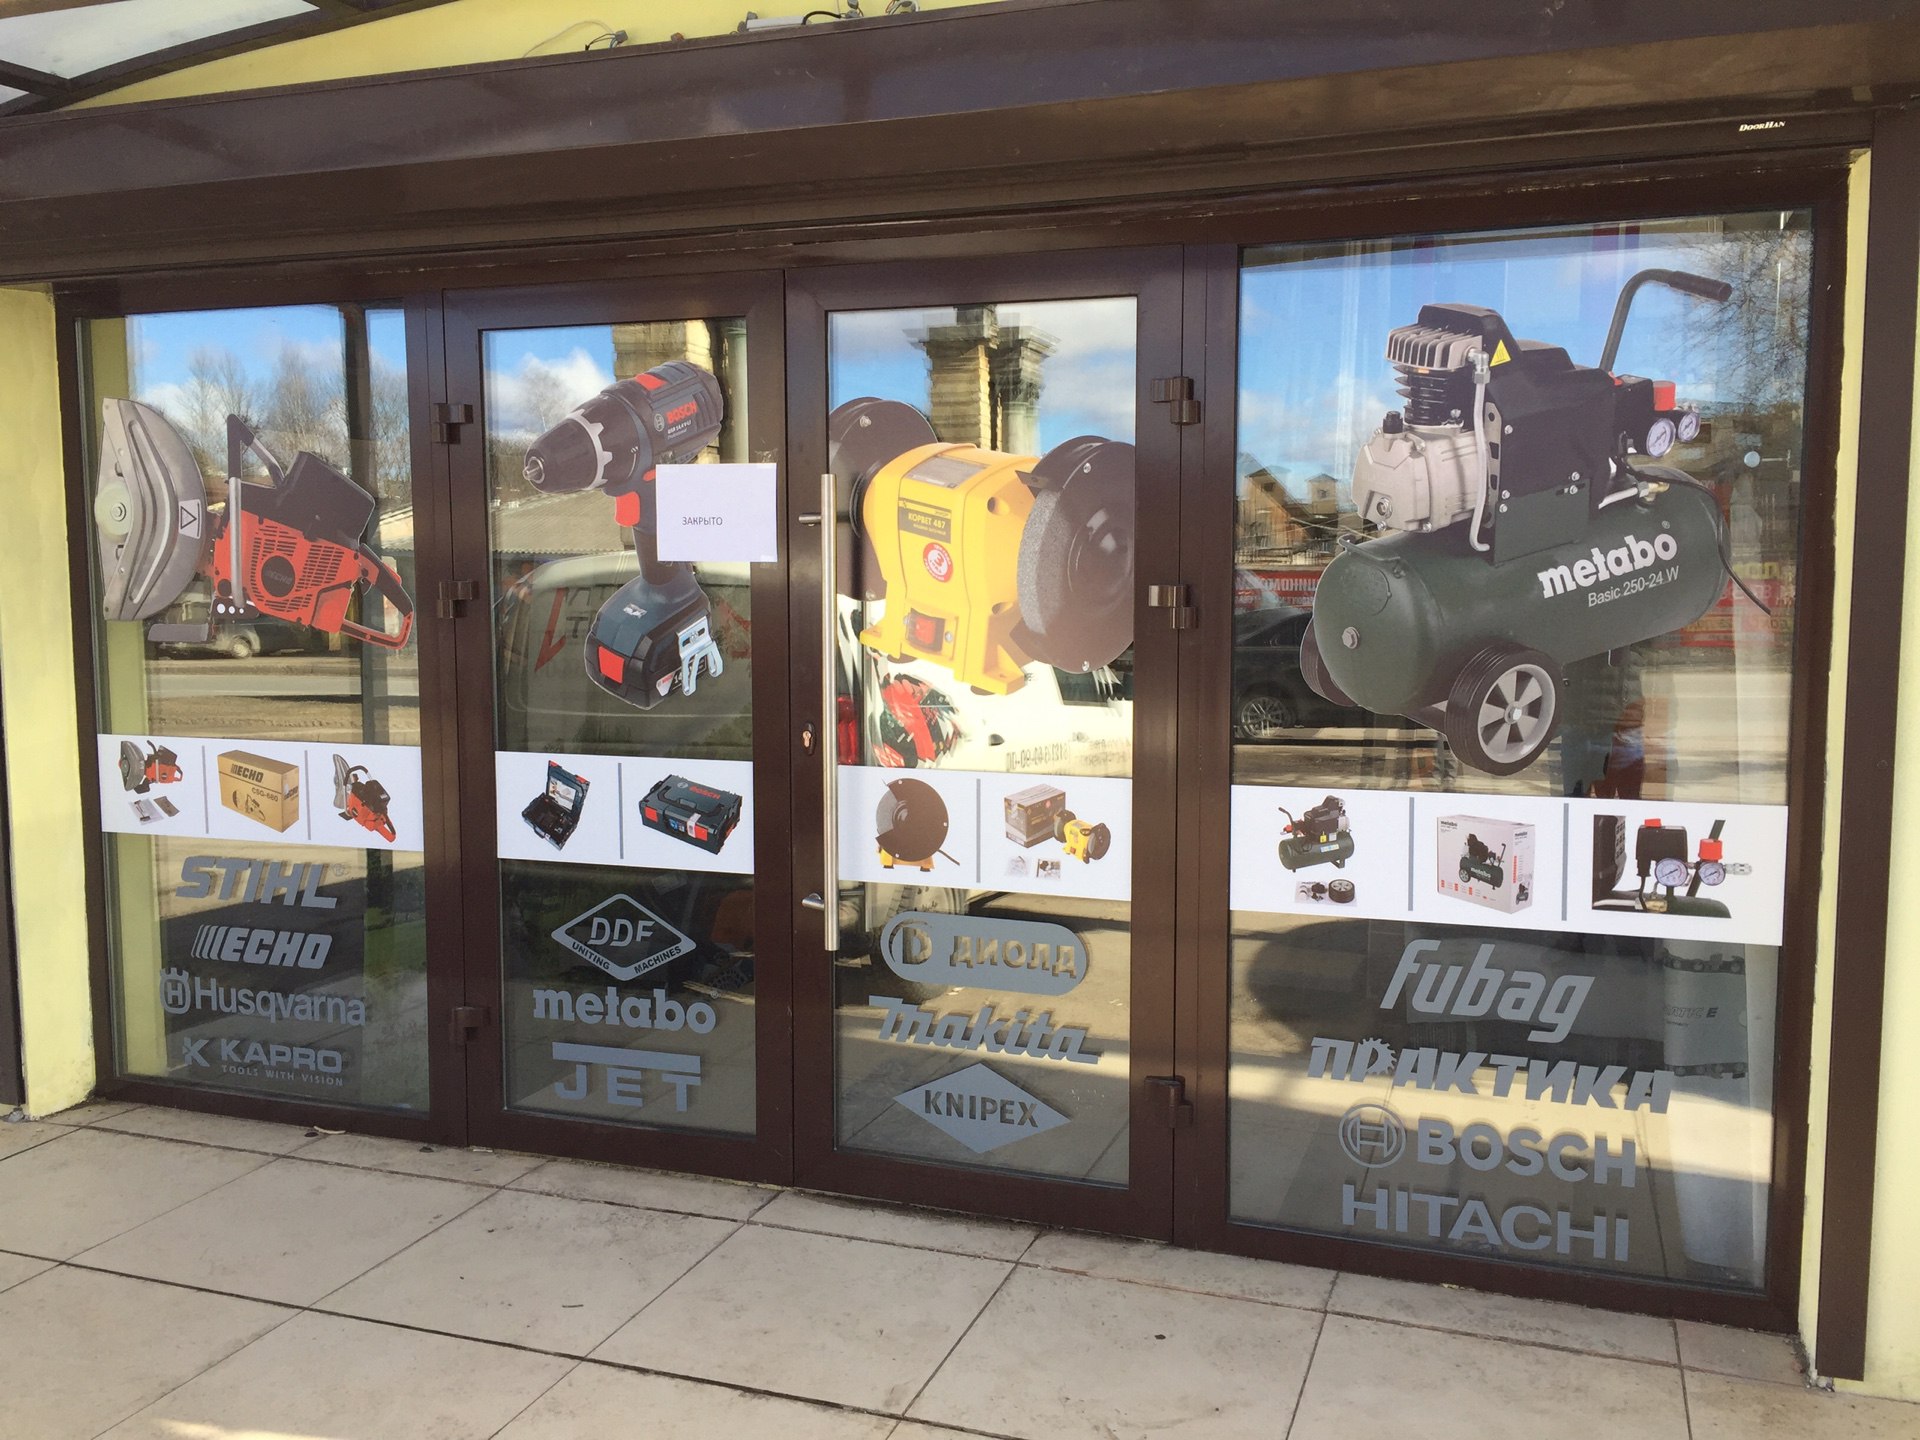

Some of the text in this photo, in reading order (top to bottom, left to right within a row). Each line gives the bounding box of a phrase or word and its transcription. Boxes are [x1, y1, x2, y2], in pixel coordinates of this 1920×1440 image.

[667, 402, 697, 424] BOSCH
[682, 516, 723, 526] ЗАКРЫТО
[908, 512, 932, 526] КОРВЕТ
[1537, 533, 1678, 599] metabo
[1588, 565, 1680, 607] Basic 250-24 W
[236, 764, 264, 784] ECHO
[175, 855, 338, 909] STIHL
[218, 926, 334, 970] ECHO
[587, 917, 656, 947] DDF
[572, 941, 682, 975] UNITING MACHINES
[949, 935, 1077, 979] ДИОЛД
[194, 976, 366, 1026] Husqvarna
[532, 986, 717, 1035] metabo
[1380, 938, 1595, 1044] fubag
[221, 1038, 343, 1074] KAPRO
[222, 1065, 343, 1086] TOOLS WITH VISION
[1307, 1036, 1673, 1114] ПРАКТИКА
[554, 1063, 701, 1112] JET
[924, 1088, 1039, 1128] KNIPEX
[1418, 1119, 1636, 1187] BOSCH
[1341, 1184, 1630, 1262] HITACHI
